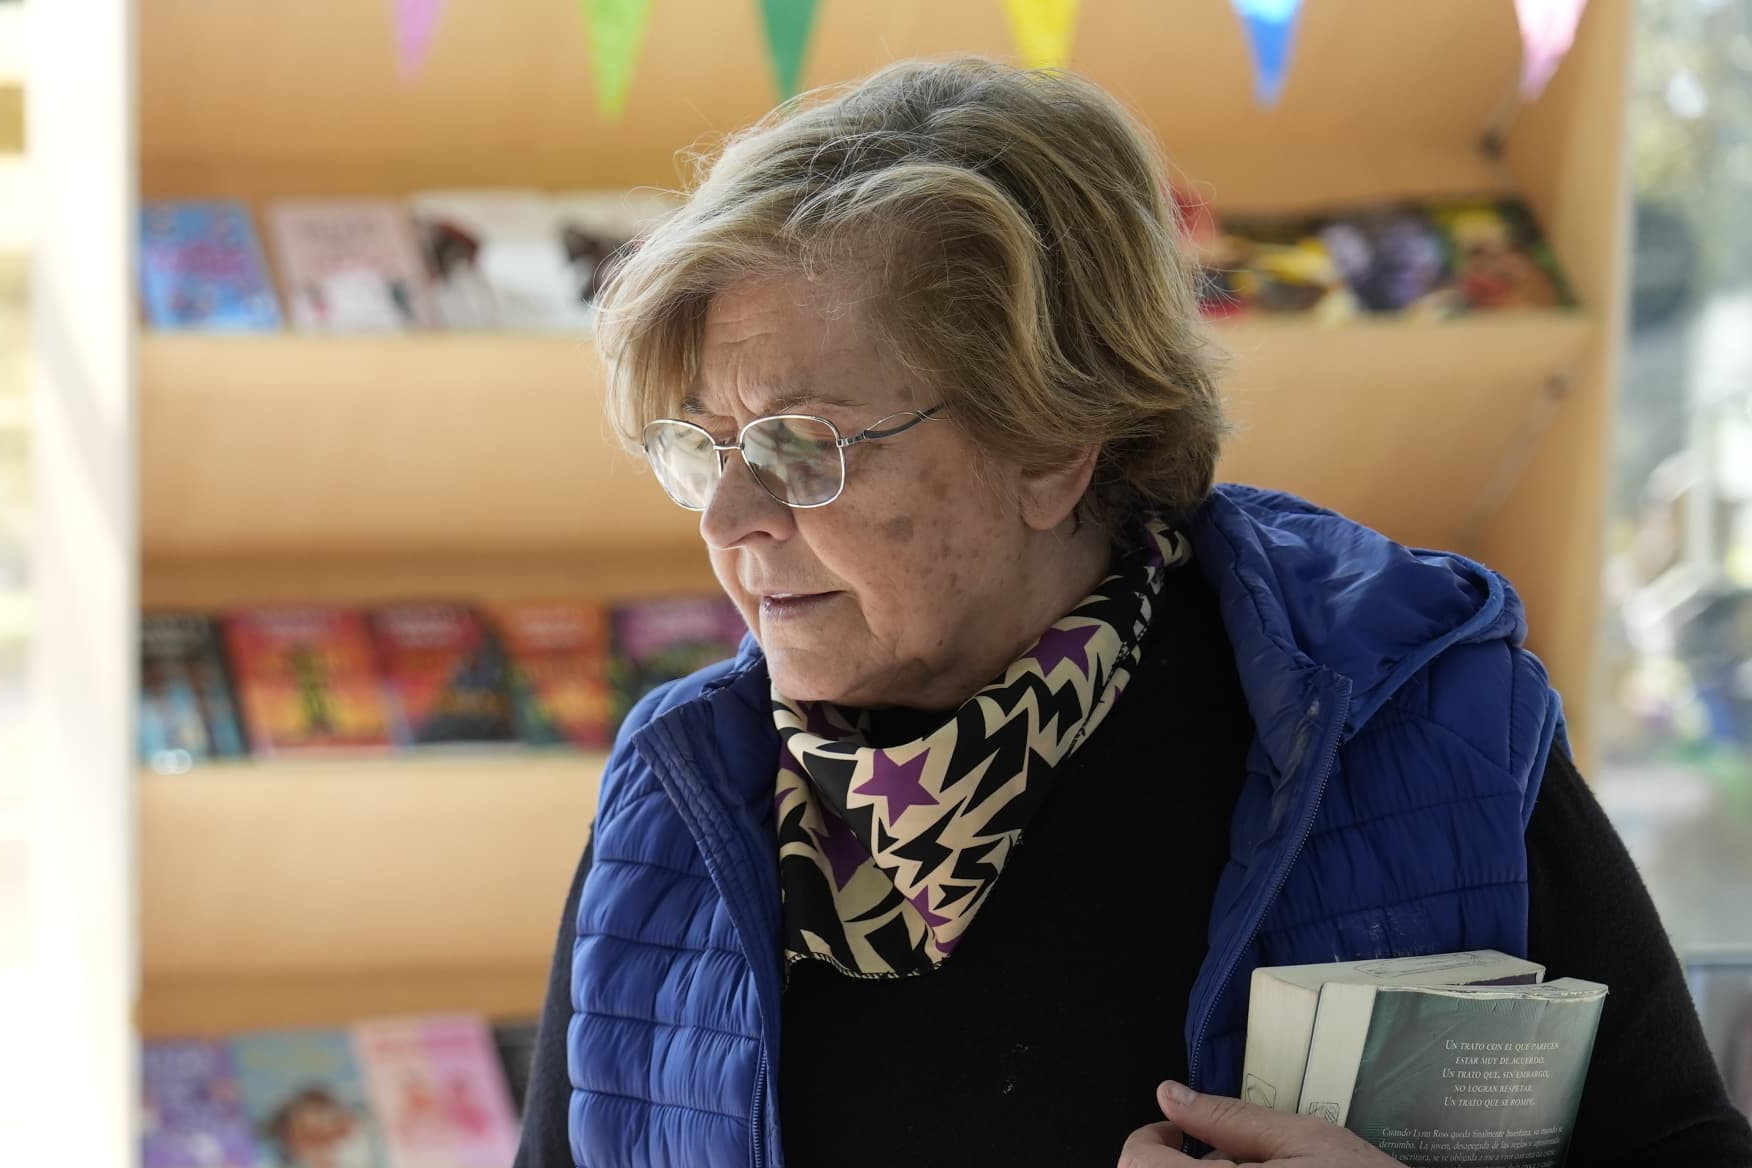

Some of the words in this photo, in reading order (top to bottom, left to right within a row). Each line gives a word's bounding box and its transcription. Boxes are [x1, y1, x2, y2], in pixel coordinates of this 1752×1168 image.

[1460, 1042, 1484, 1051] TRATO
[1486, 1042, 1503, 1051] CON
[1455, 1056, 1479, 1065] ESTAR
[1480, 1056, 1498, 1065] MUY
[1456, 1070, 1482, 1080] TRATO
[1454, 1084, 1466, 1093] NO
[1468, 1084, 1497, 1093] LOGRAN
[1458, 1098, 1483, 1107] TRATO
[1382, 1128, 1412, 1138] Cuando
